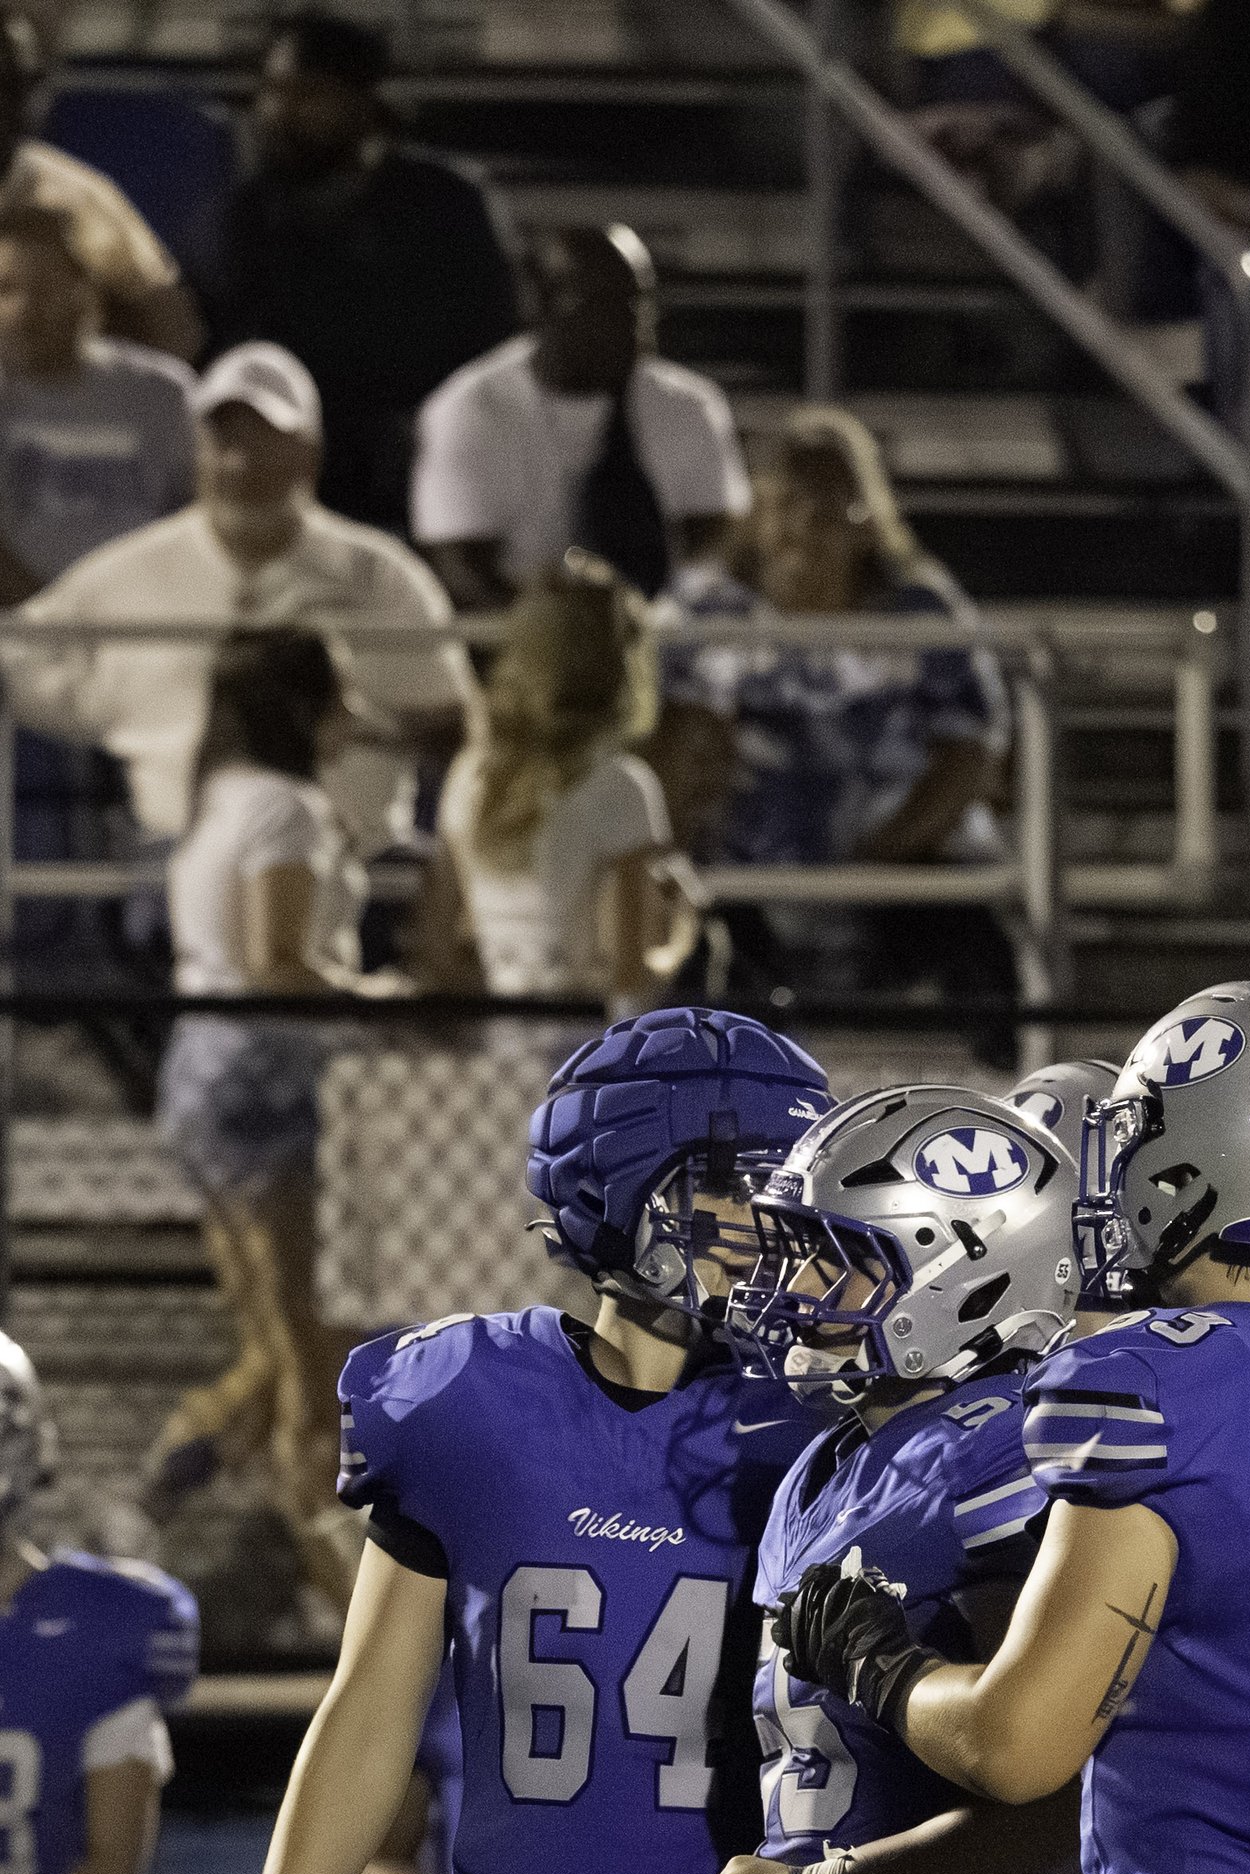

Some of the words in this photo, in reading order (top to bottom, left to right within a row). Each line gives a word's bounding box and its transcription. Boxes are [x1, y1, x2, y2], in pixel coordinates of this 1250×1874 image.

[1141, 1018, 1235, 1083] M
[920, 1129, 1023, 1193] M
[566, 1506, 687, 1553] Vikings
[499, 1561, 734, 1813] 64
